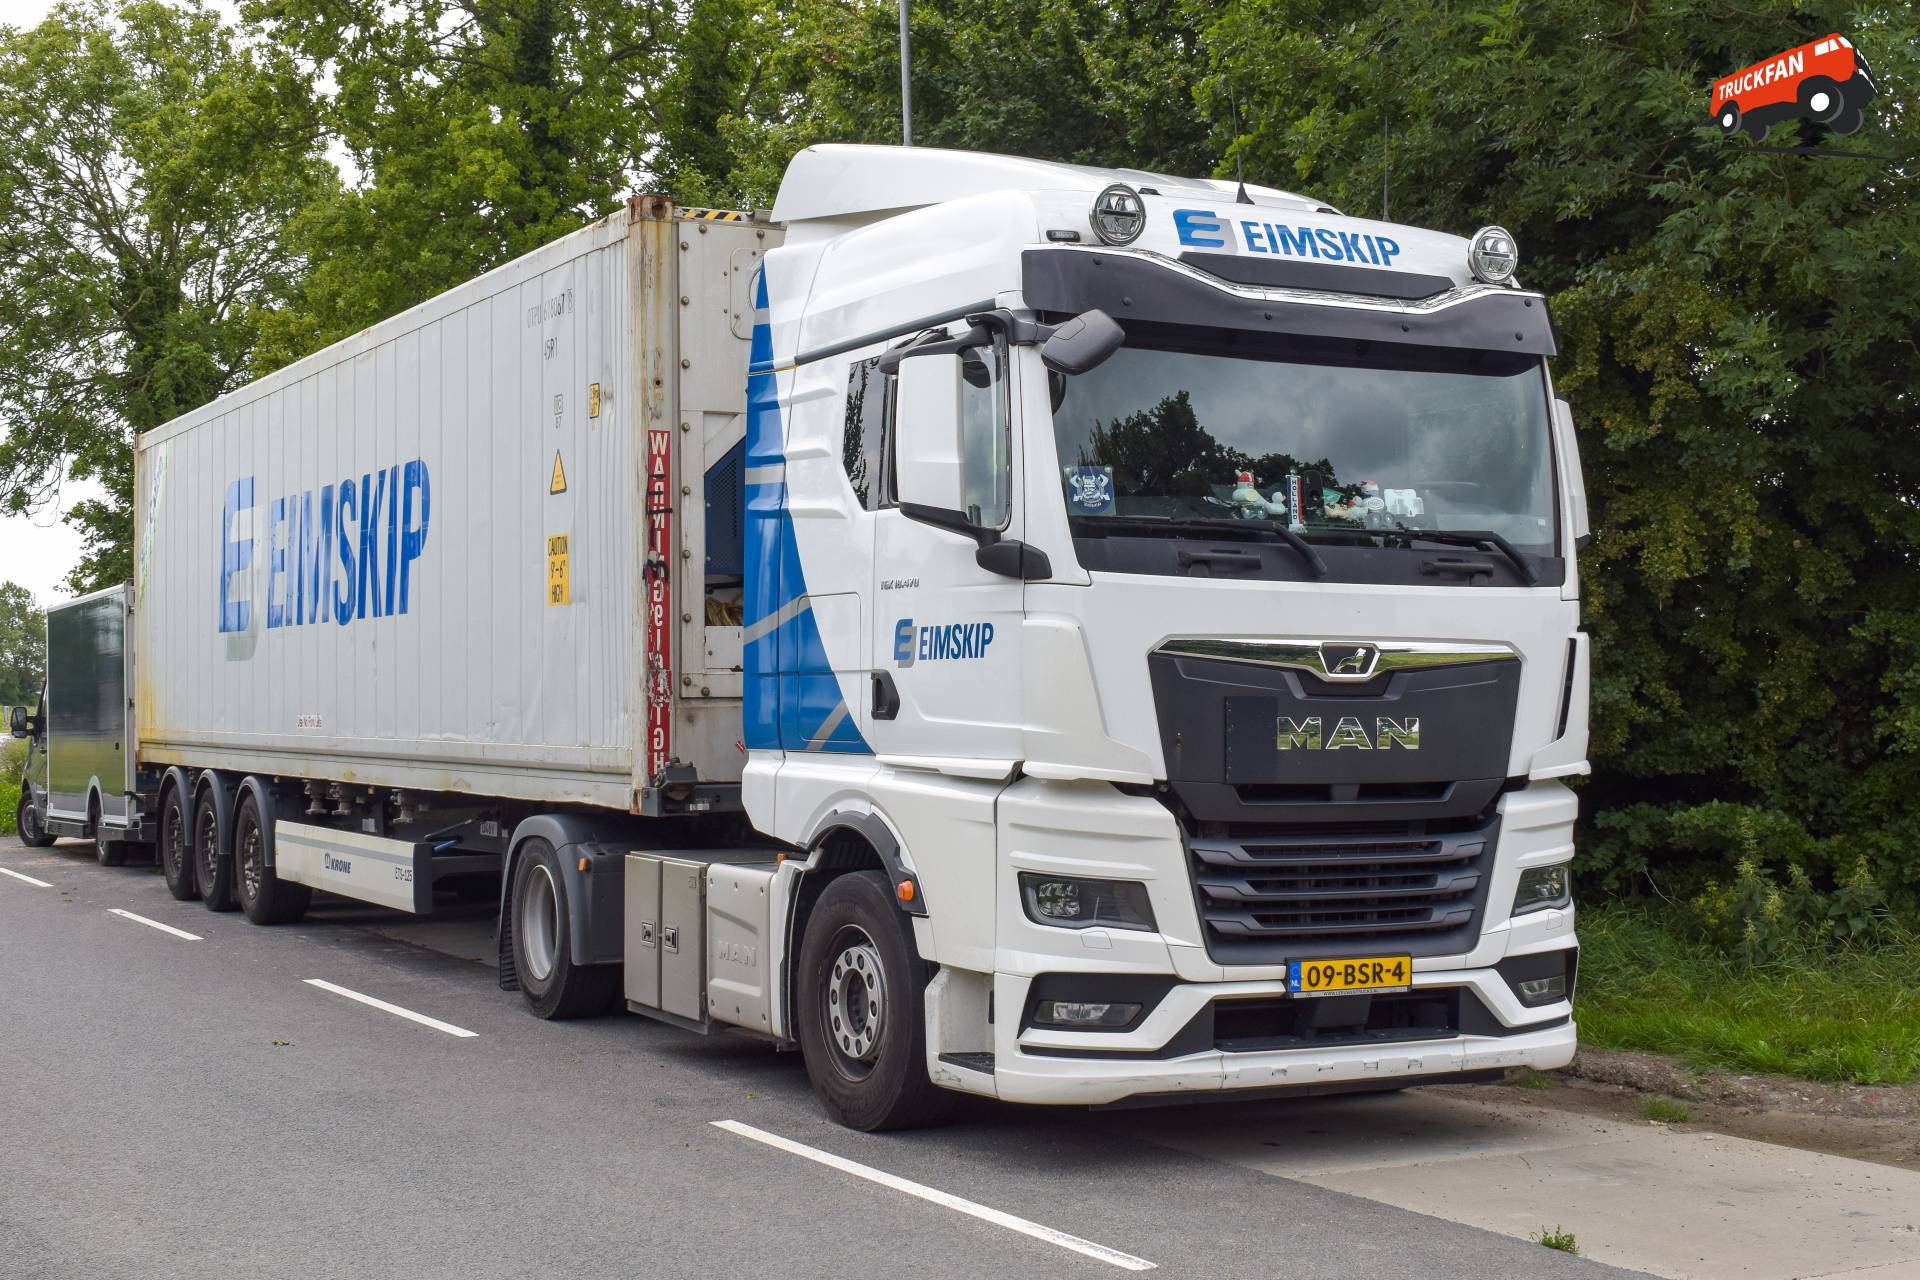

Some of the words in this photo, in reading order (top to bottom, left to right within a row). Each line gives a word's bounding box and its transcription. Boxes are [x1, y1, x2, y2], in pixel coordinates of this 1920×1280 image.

[1240, 220, 1401, 266] EIMSKIP
[267, 457, 431, 627] EIMSKIP
[548, 536, 568, 556] CAUTION
[552, 584, 563, 603] HIGH
[918, 622, 994, 661] EIMSKIP
[1276, 716, 1420, 750] MAN
[330, 858, 352, 874] KRONE
[717, 940, 758, 968] MAN
[1291, 979, 1300, 987] NL
[1307, 961, 1405, 988] 09-BSR-4
